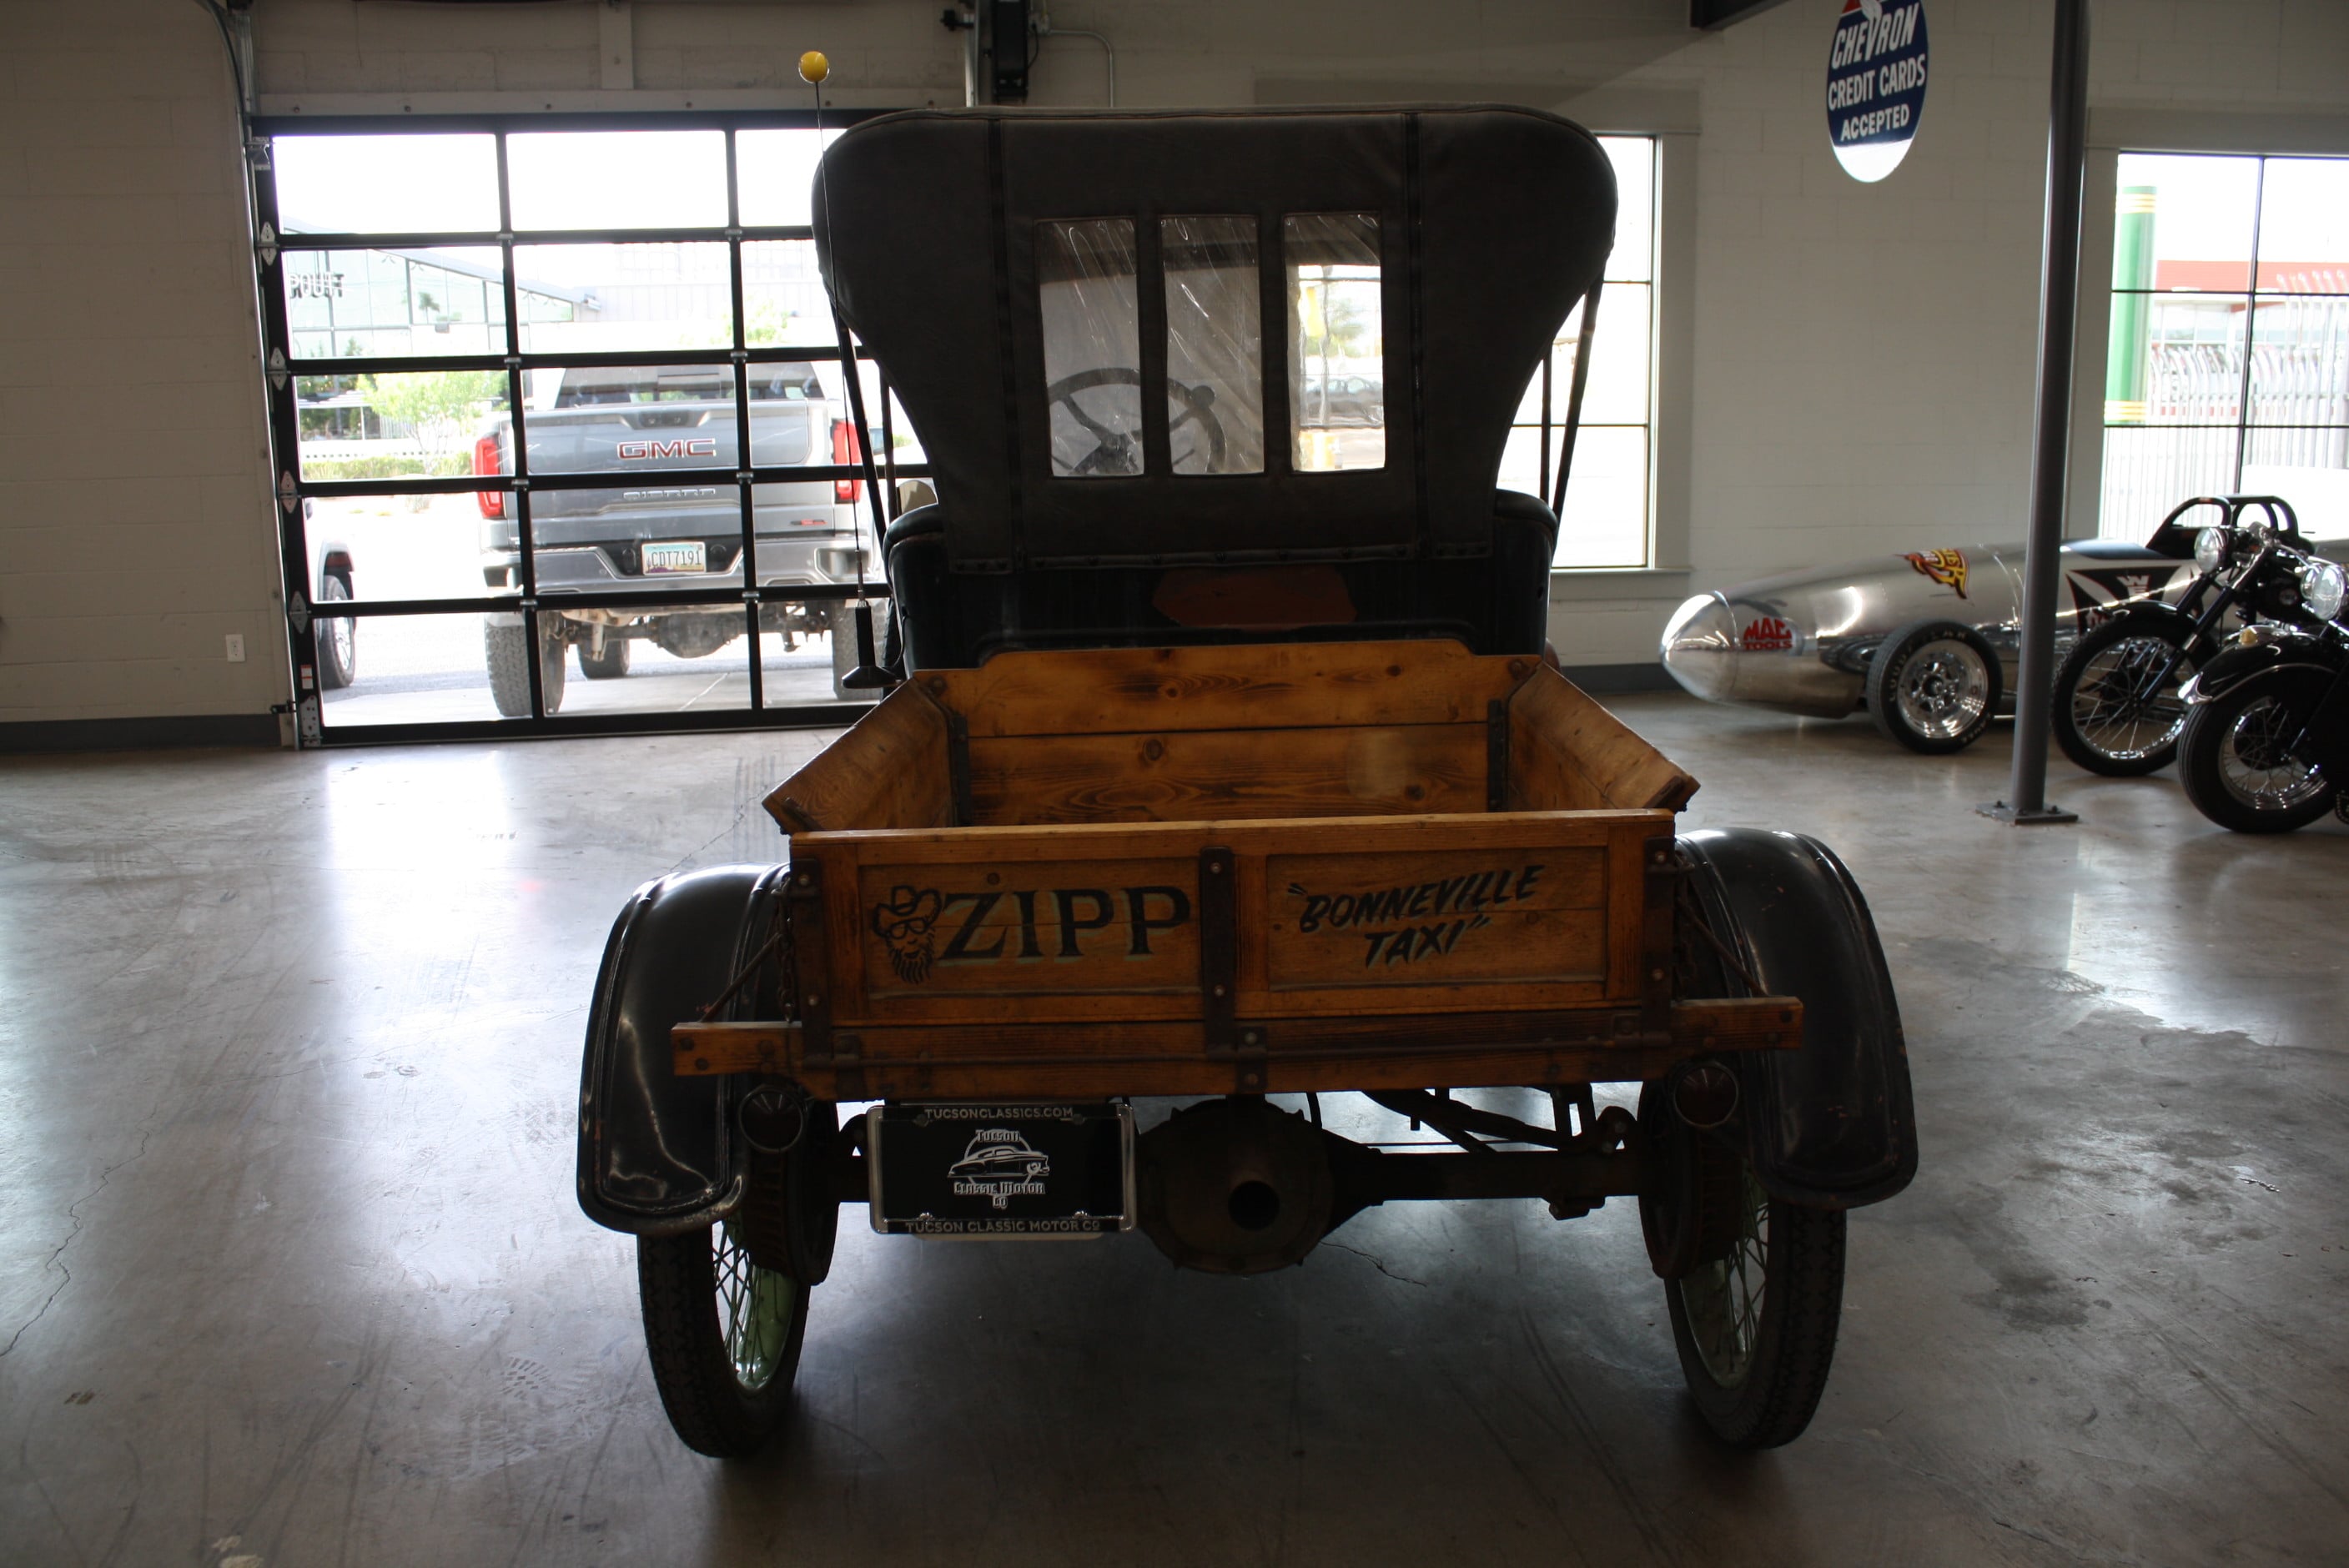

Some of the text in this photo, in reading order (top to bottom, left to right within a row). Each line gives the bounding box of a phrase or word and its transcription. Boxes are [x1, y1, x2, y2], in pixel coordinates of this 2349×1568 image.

[1831, 3, 1919, 70] CHEVRON
[1828, 53, 1926, 111] CREDIT CARDS
[1840, 103, 1909, 142] ACCEPTED
[617, 438, 716, 459] GMC
[651, 550, 702, 568] CDT7191
[1743, 616, 1793, 641] MAC
[1743, 640, 1793, 651] TOOLS
[937, 886, 1191, 967] ZIPP
[924, 1107, 1074, 1120] TUCSONCLASSICS.COM
[906, 1220, 963, 1234] TUCSON
[967, 1219, 1026, 1234] CLASSIC
[1029, 1219, 1081, 1233] MOTOR
